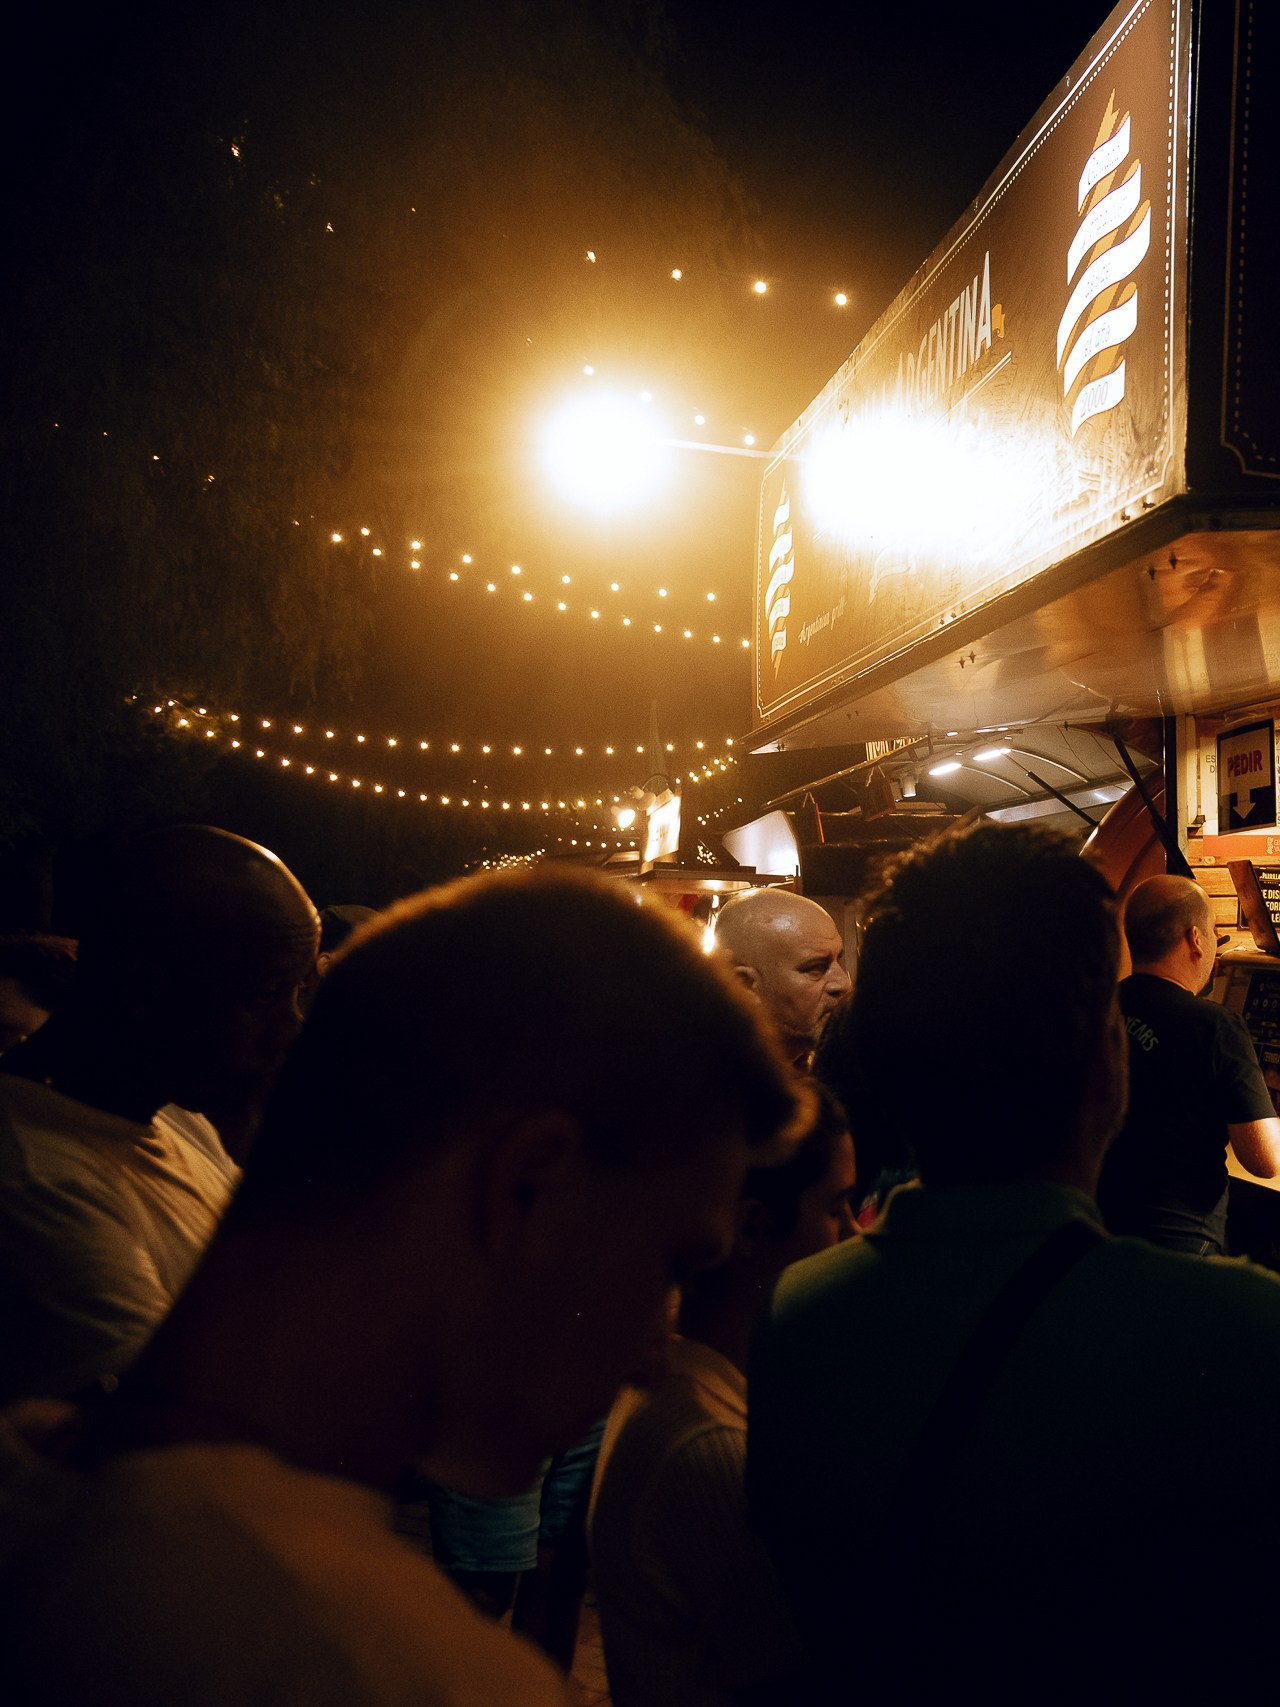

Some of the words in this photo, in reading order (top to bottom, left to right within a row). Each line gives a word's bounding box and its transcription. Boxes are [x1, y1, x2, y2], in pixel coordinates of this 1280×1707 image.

[1227, 749, 1263, 778] PEDIR
[1262, 872, 1280, 880] PARRILLA
[1125, 1015, 1160, 1052] YEARS
